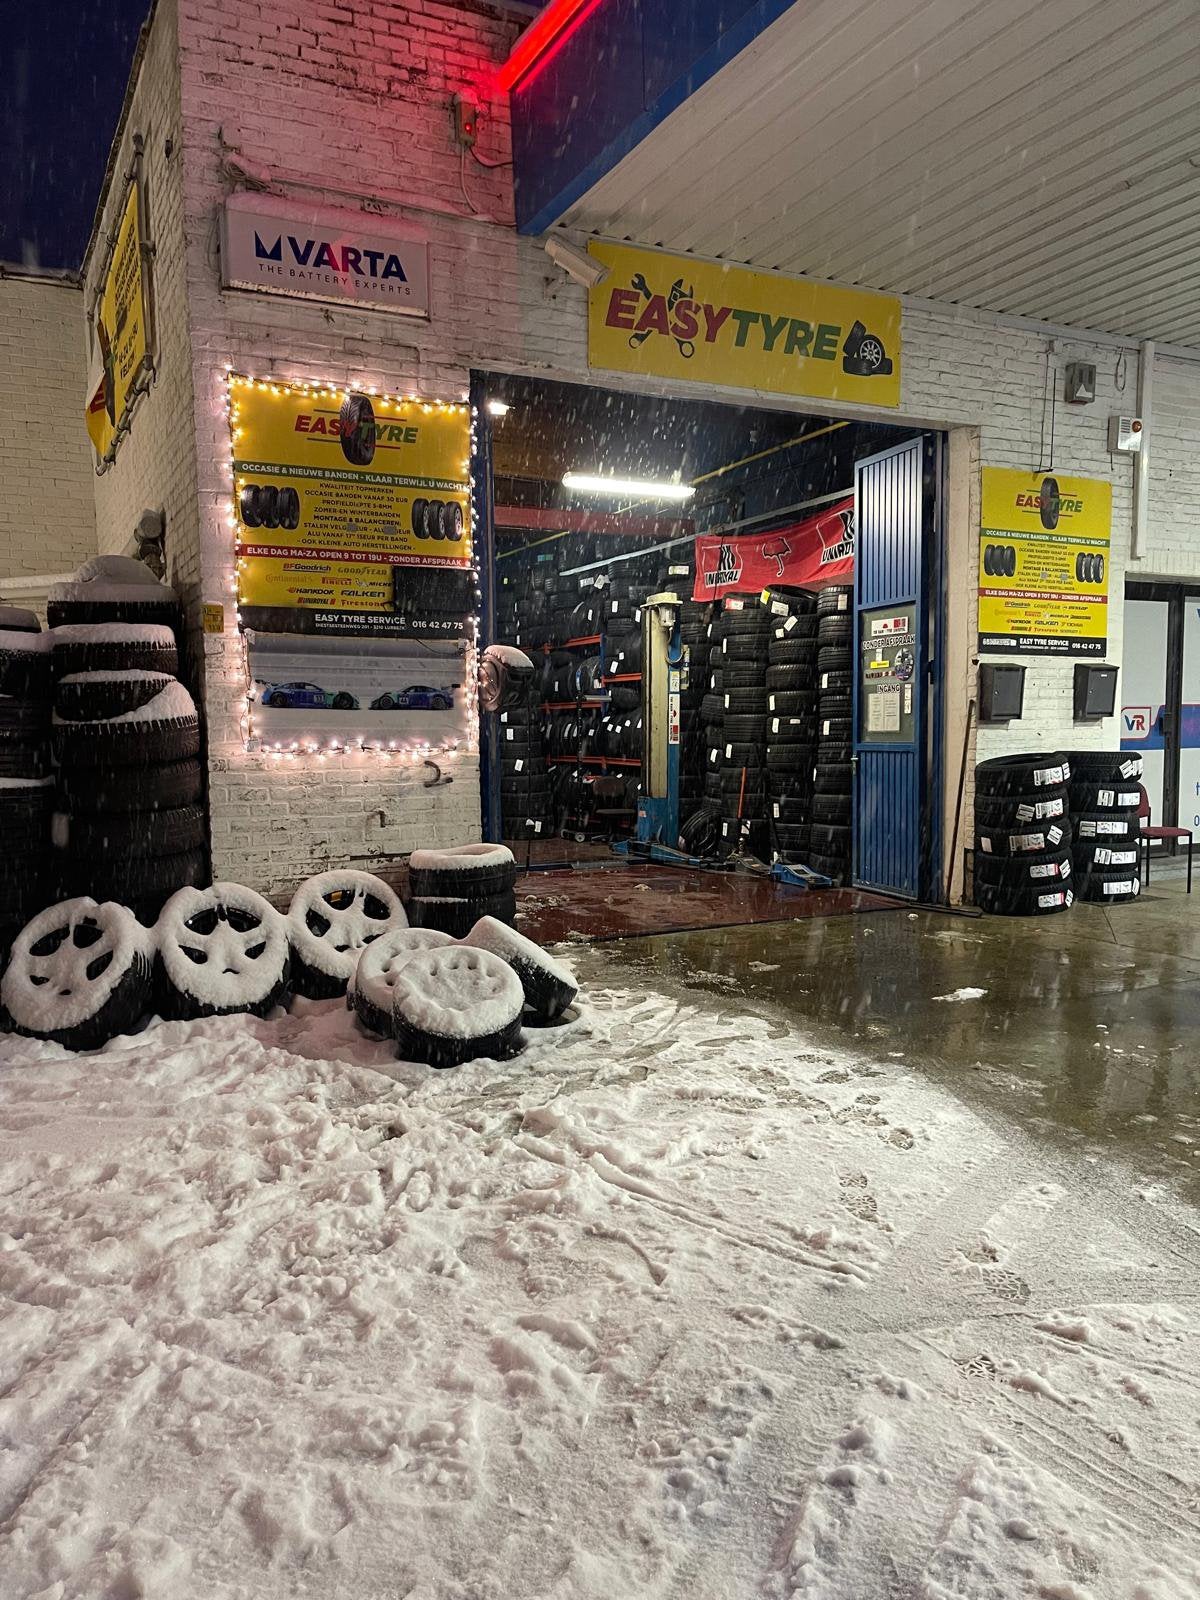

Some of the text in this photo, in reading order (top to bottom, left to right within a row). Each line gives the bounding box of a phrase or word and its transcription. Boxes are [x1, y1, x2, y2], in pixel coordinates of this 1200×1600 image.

[287, 236, 408, 282] VARTA
[259, 264, 411, 296] THE BATTERY EXPERTS
[242, 463, 280, 473] OCCASIE
[289, 468, 324, 477] NIEUWE
[325, 470, 358, 480] BANDEN
[366, 474, 392, 483] KLAAR
[394, 476, 428, 487] TERWIJL
[356, 485, 394, 494] TOPMERKEN
[350, 509, 400, 518] WINTERBANDEN
[247, 546, 269, 555] ELKE
[270, 548, 288, 556] DAG
[290, 550, 318, 558] MA-ZA
[368, 554, 382, 562] 19U
[388, 555, 420, 563] ZONDER
[422, 558, 462, 566] AFSPRAAK
[283, 563, 332, 572] BFGoodrich
[341, 590, 386, 598] FALKEN
[315, 614, 406, 625] EASY TYRE SERVICE
[877, 684, 900, 693] INGANG
[1124, 714, 1146, 731] VR
